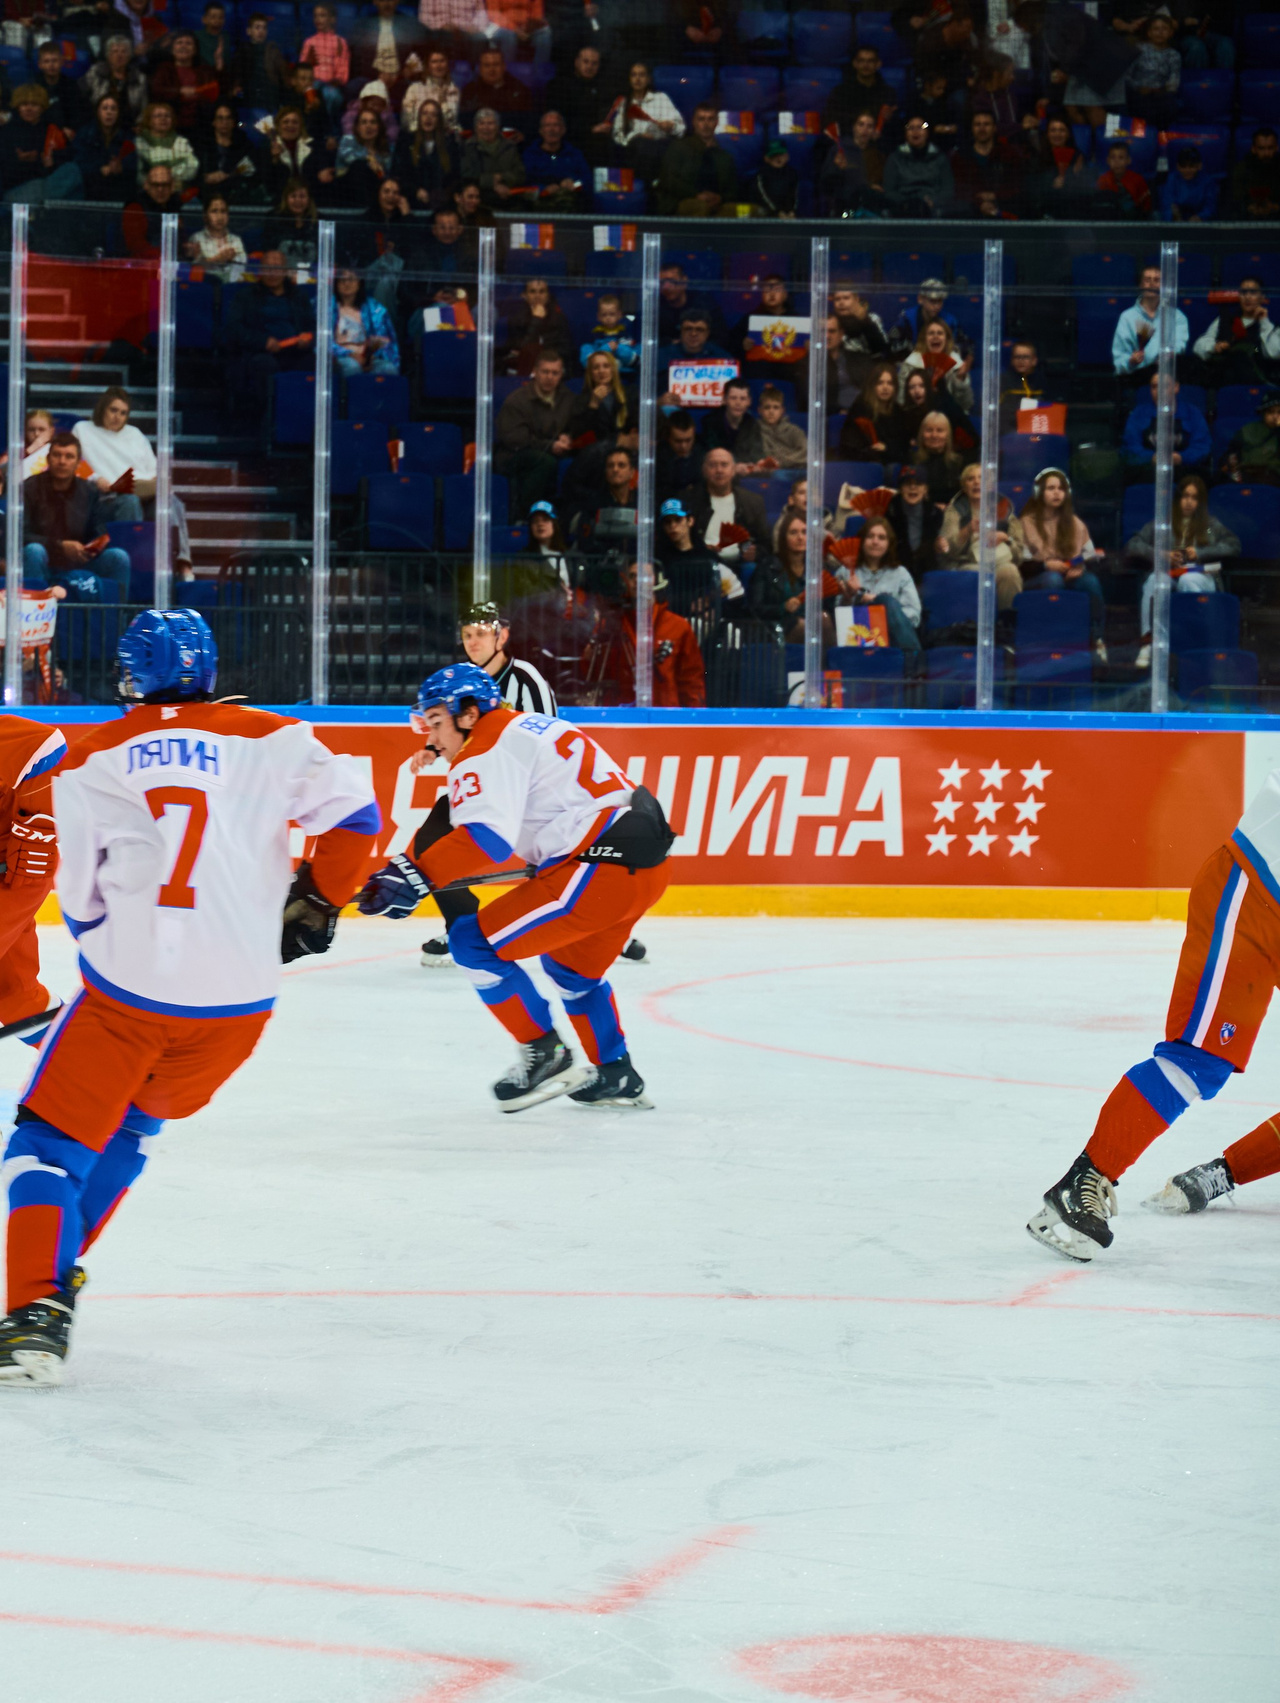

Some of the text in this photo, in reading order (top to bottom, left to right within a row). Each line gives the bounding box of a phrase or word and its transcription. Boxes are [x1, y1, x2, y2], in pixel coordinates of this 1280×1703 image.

[452, 772, 482, 808] 23
[624, 755, 904, 857] ШИНА
[11, 821, 57, 843] CM
[144, 785, 209, 910] 7
[389, 854, 430, 897] AUER
